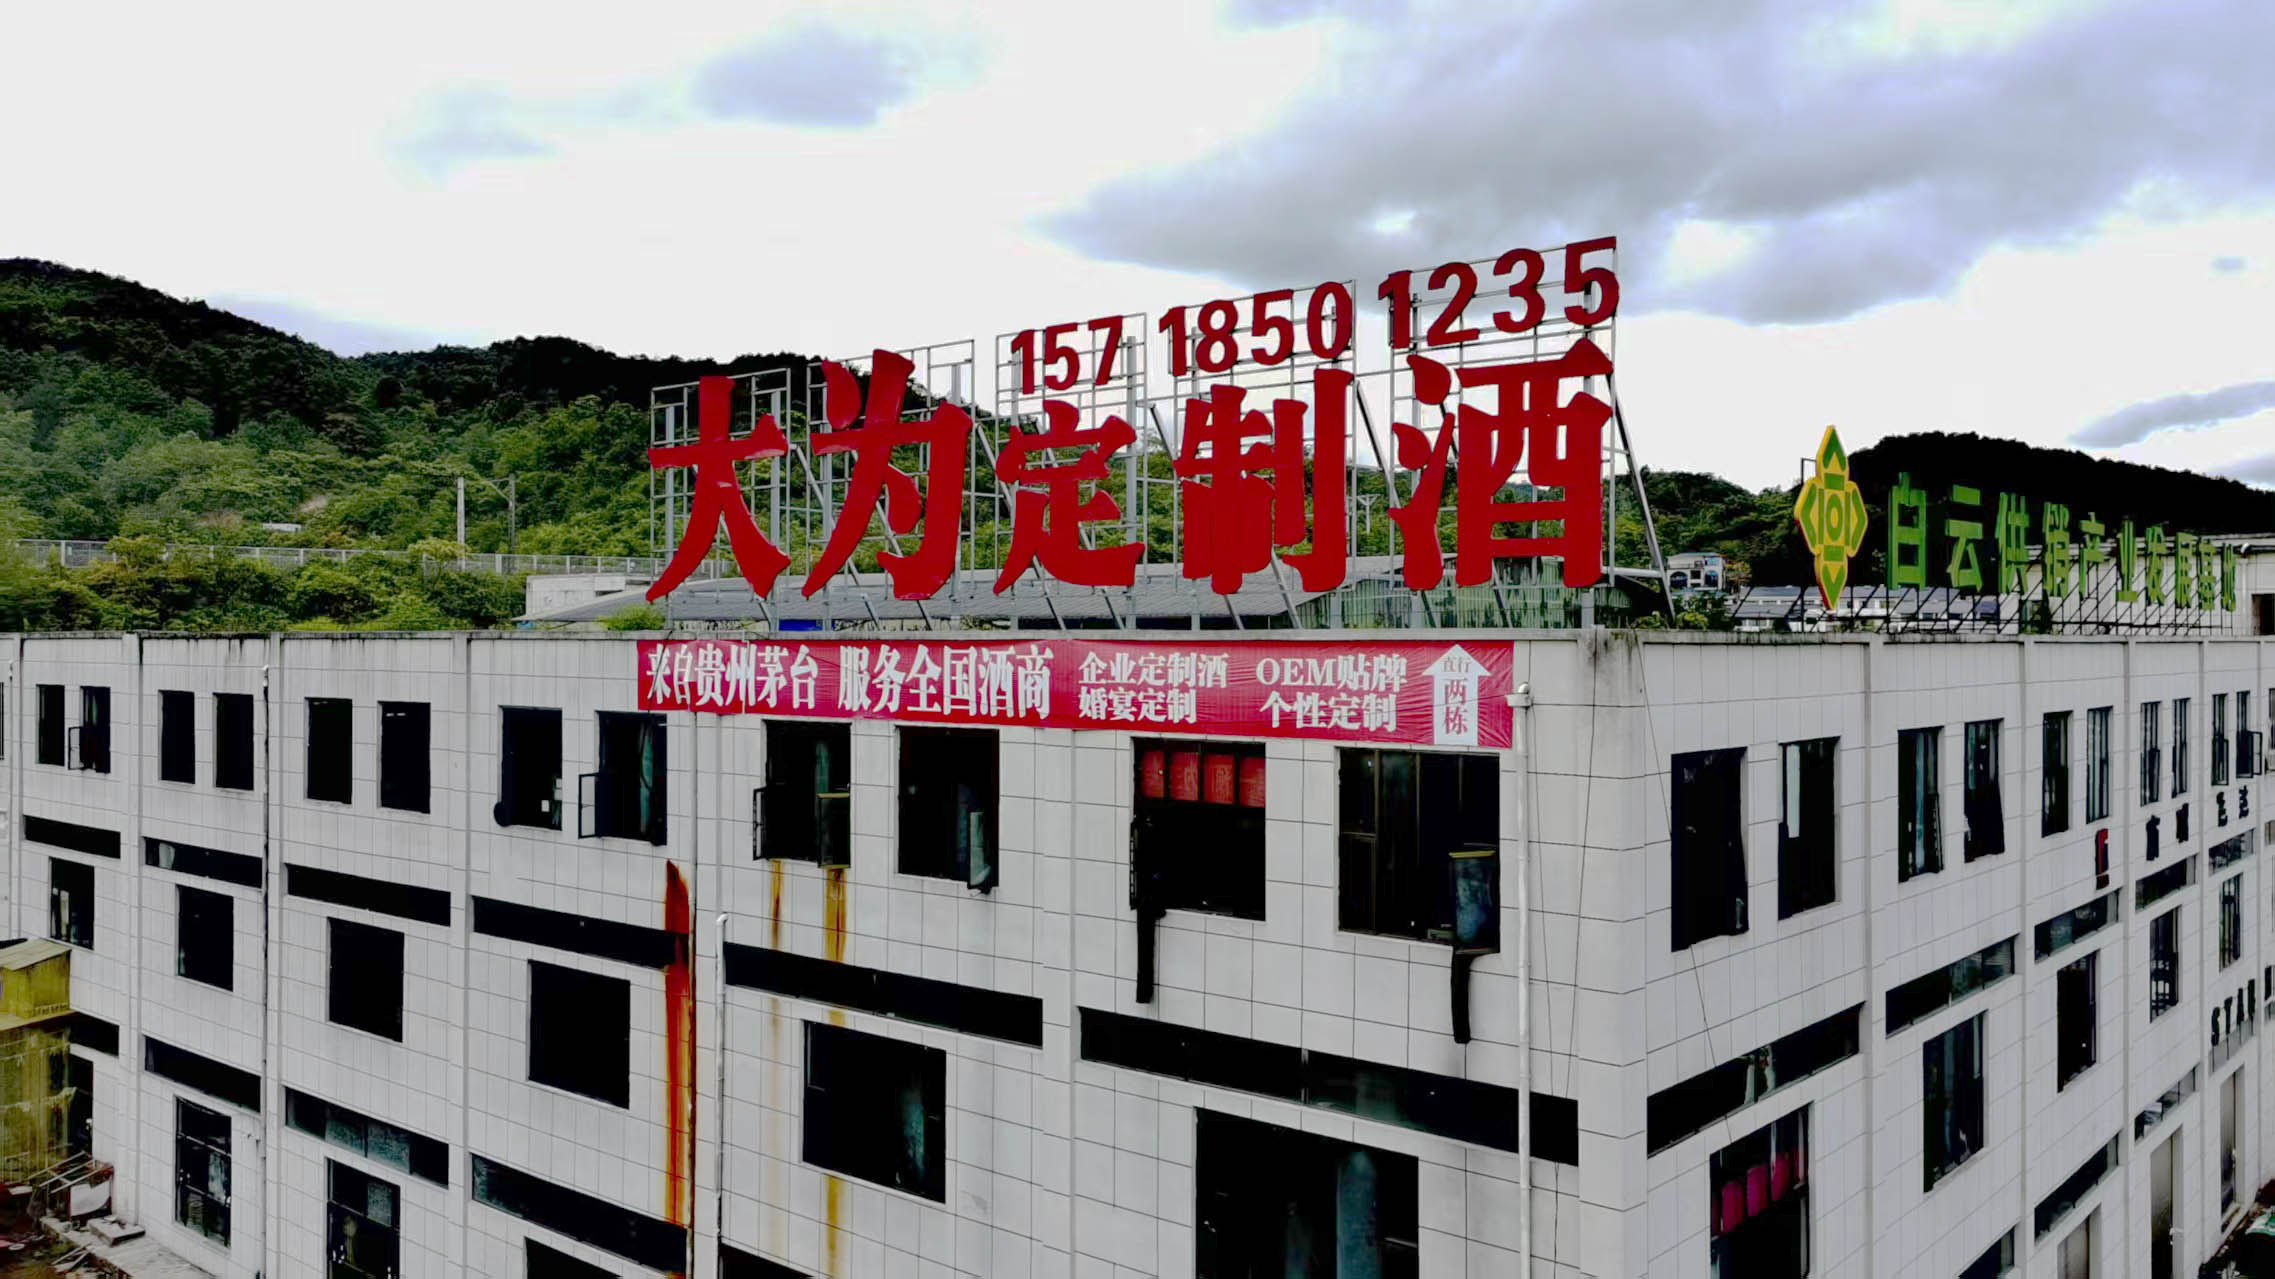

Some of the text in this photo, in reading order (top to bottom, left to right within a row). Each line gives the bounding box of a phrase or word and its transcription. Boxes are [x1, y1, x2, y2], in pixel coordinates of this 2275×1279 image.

[1011, 236, 1620, 394] 157 1850 1235
[646, 338, 1615, 602] 大为定制酒
[646, 642, 1054, 719] 来自贵州茅台 服务全国酒商
[1078, 651, 1229, 688] 企业定制酒
[1255, 653, 1408, 692] OEM贴牌
[1078, 686, 1197, 723] 婚宴定制
[1259, 691, 1397, 732] 个性定制
